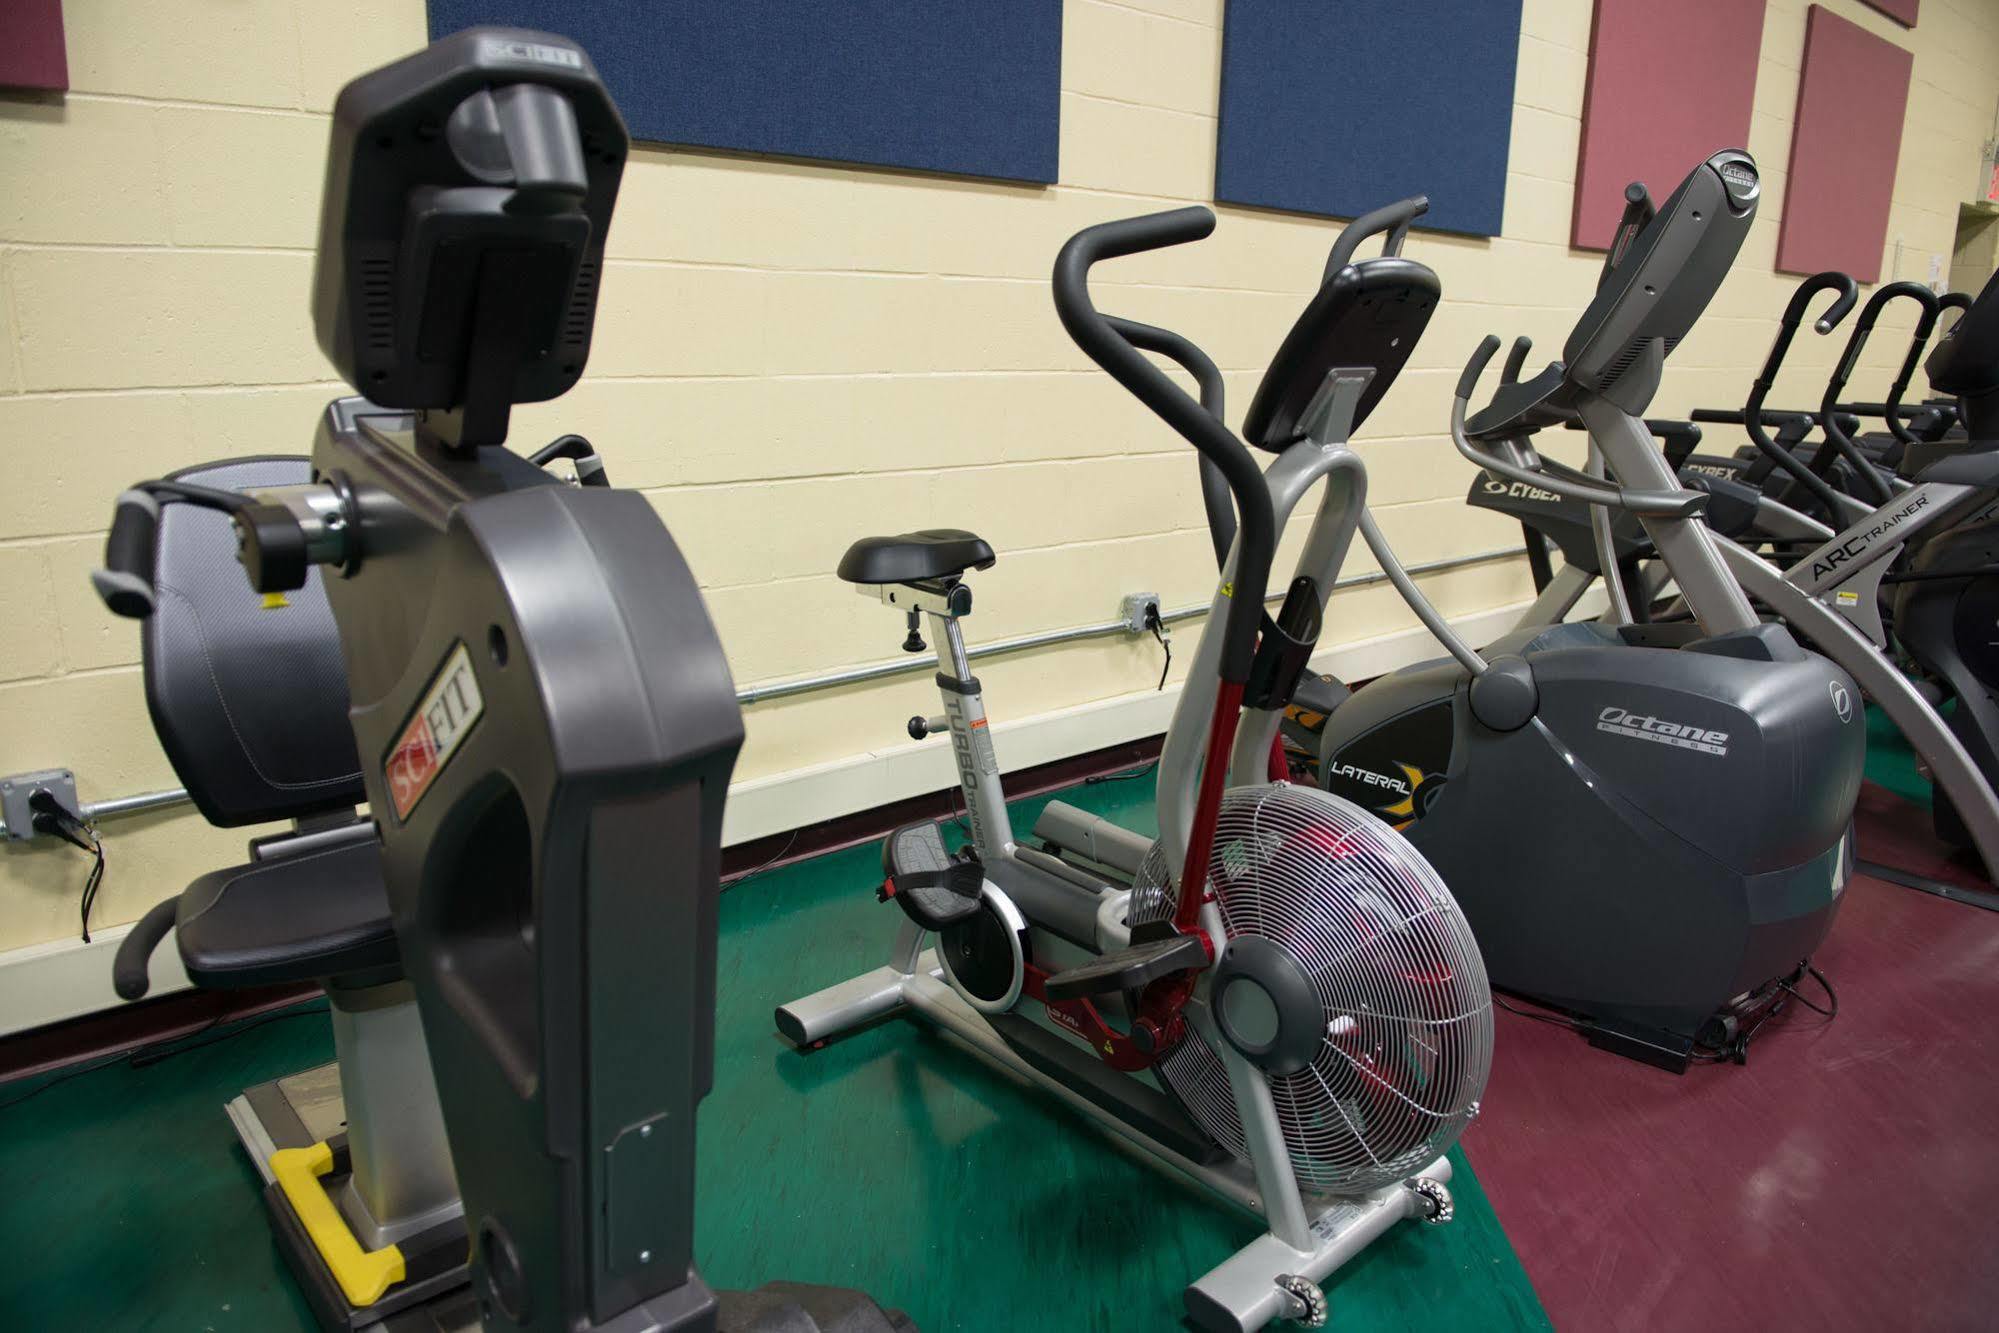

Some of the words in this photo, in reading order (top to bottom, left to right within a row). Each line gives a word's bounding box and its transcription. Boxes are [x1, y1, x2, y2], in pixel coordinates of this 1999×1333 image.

[392, 664, 469, 804] SCIFIT
[1599, 706, 1729, 745] Octane
[1600, 723, 1722, 754] FITNESS
[1331, 761, 1410, 796] LATERAL
